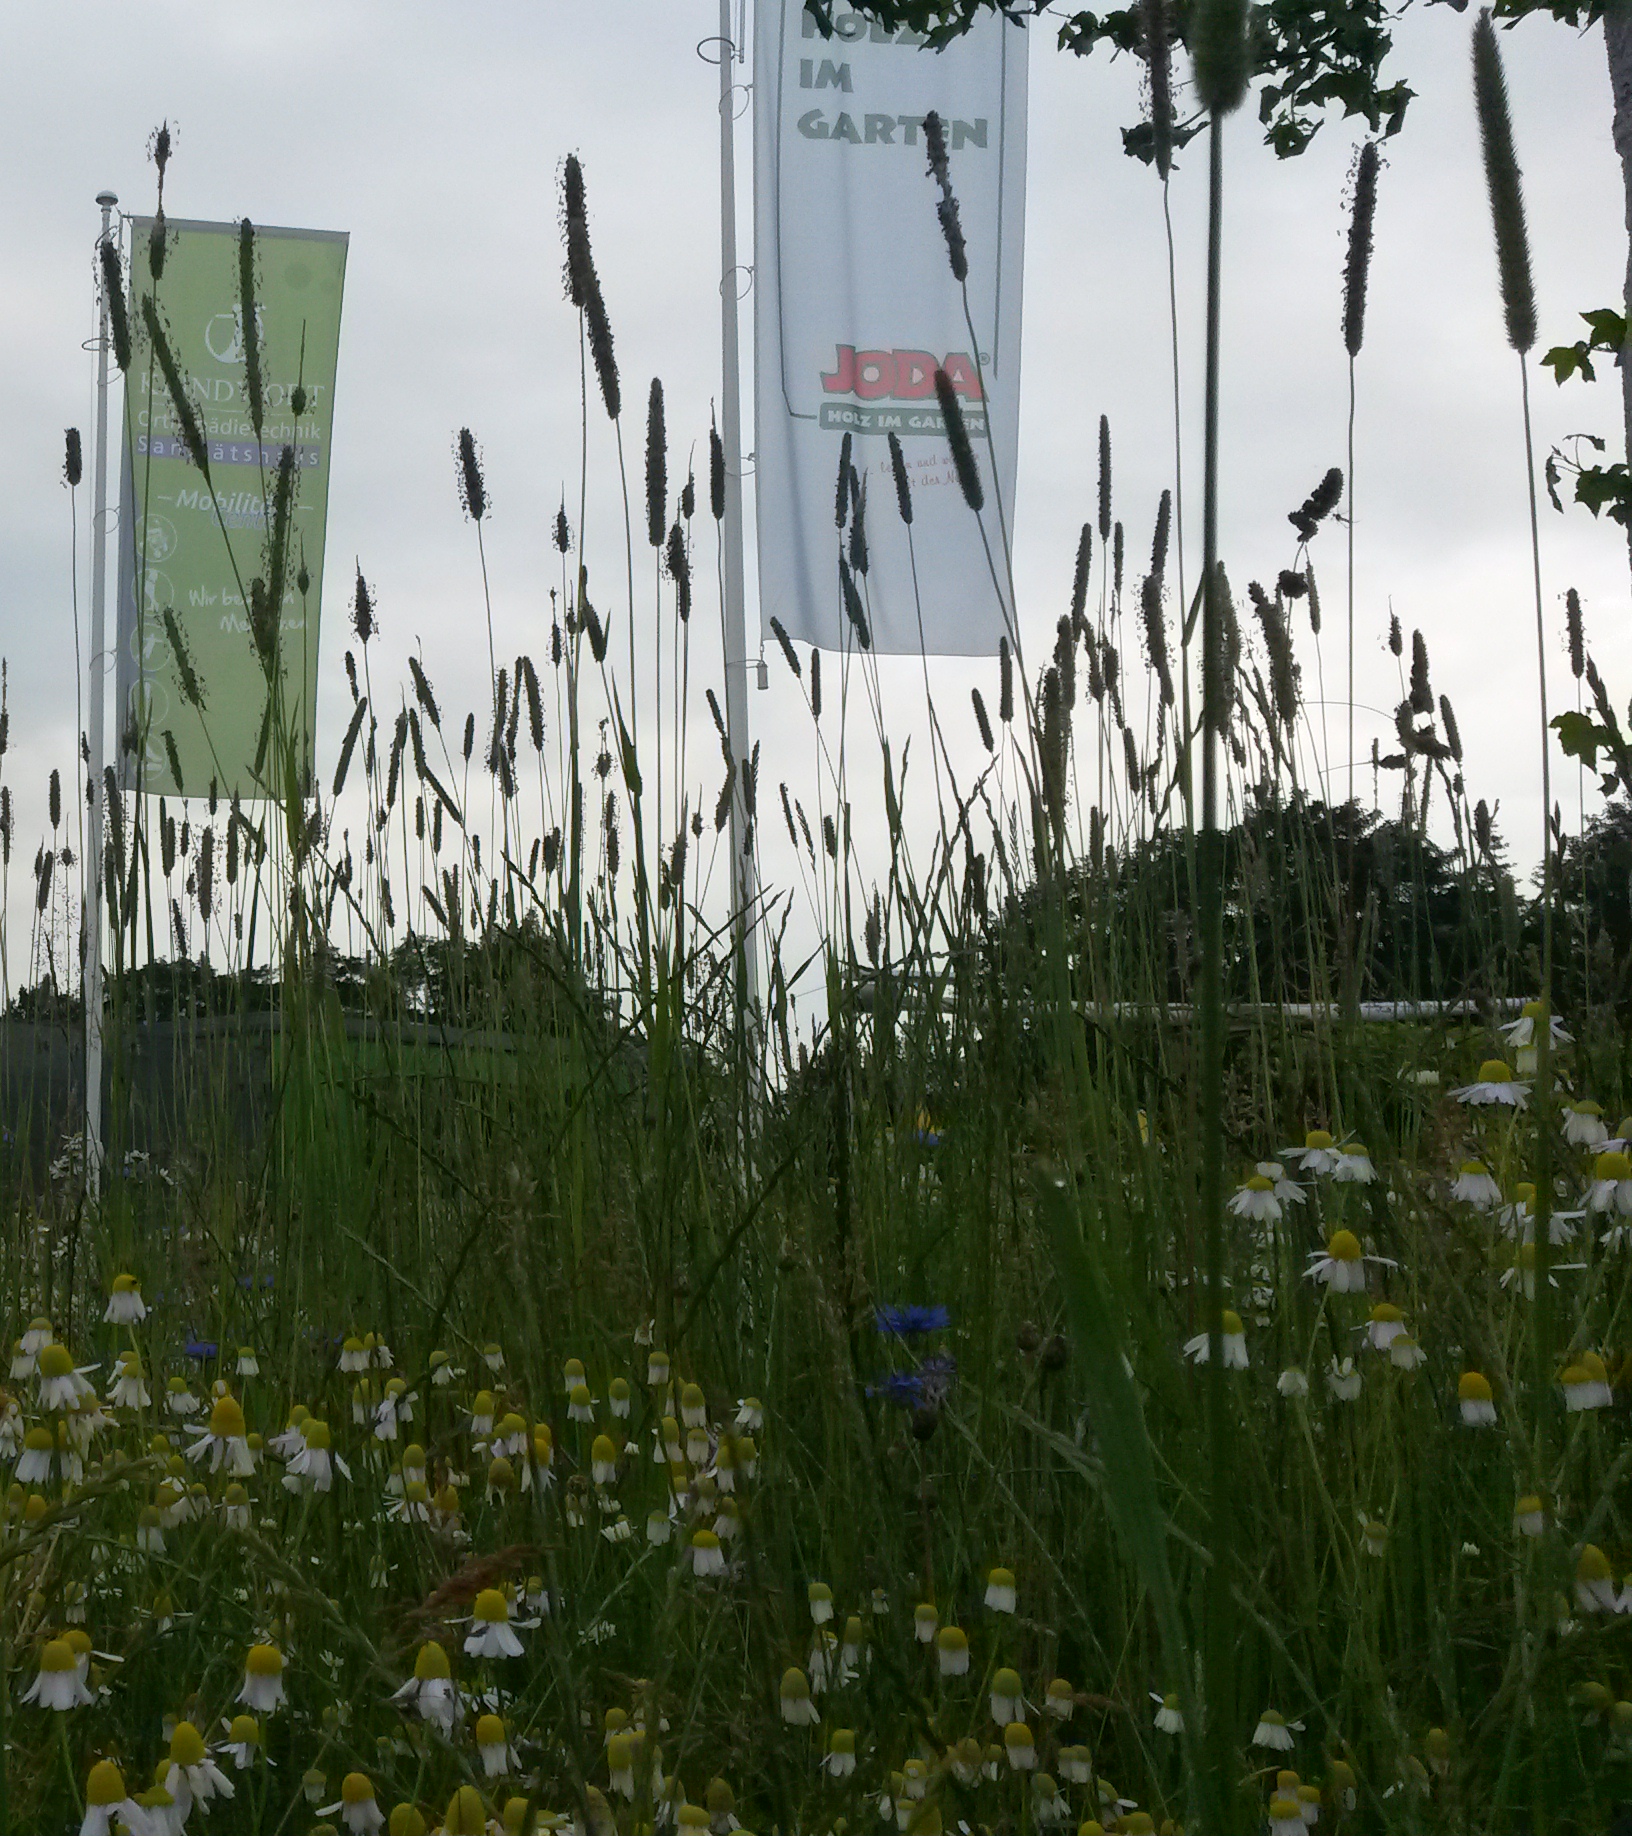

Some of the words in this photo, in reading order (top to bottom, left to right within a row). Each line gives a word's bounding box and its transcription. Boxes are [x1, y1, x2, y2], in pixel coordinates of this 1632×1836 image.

[800, 59, 854, 93] IM
[820, 344, 990, 402] JODA
[827, 410, 871, 428] HOLZ
[878, 415, 902, 428] IM
[189, 585, 217, 607] Wir
